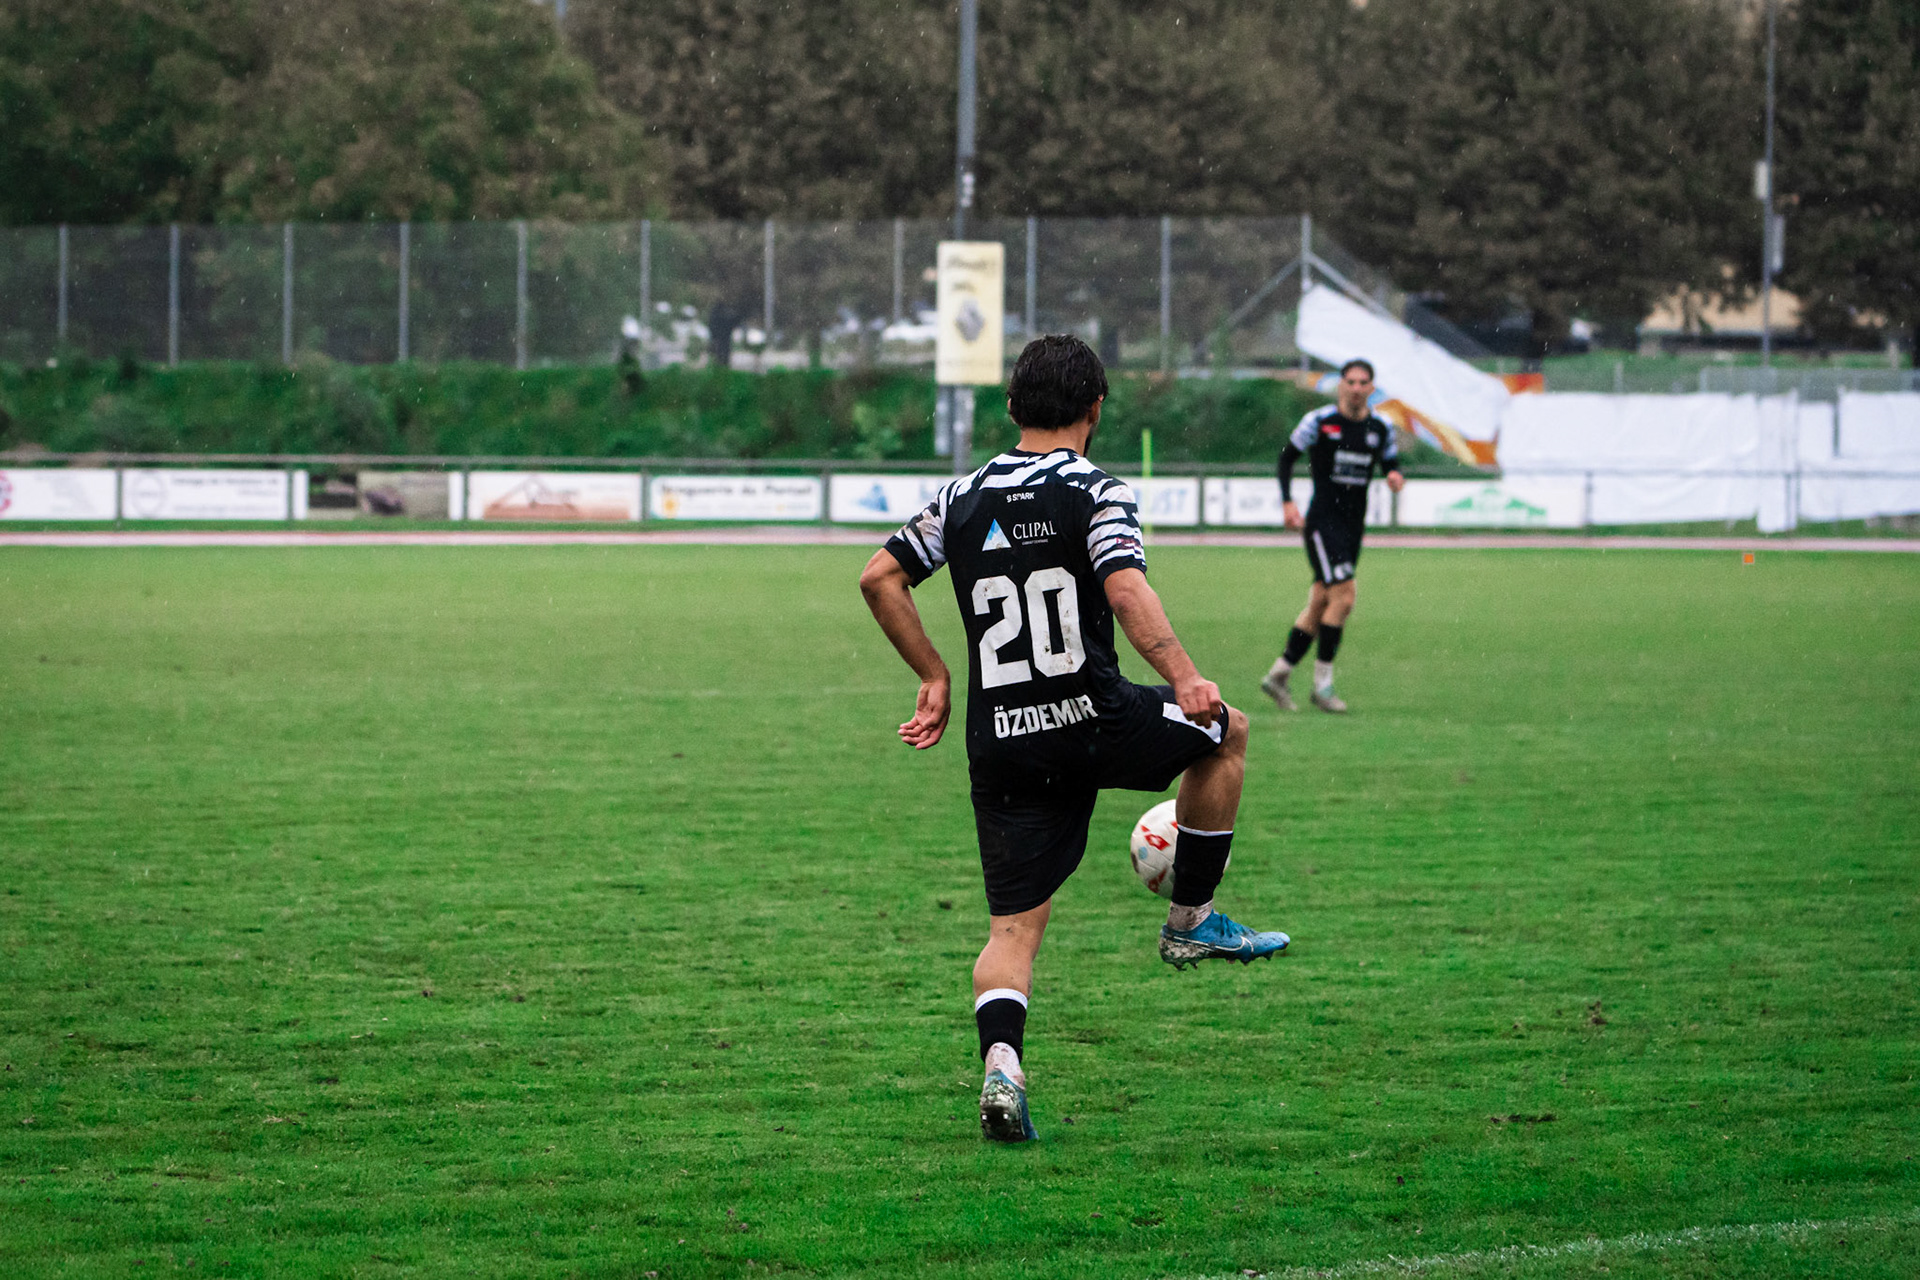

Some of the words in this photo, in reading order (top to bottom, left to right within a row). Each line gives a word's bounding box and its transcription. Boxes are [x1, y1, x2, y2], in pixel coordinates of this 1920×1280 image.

[1012, 491, 1035, 502] SPARK
[1012, 520, 1057, 540] CLIPAL
[971, 567, 1087, 690] 20
[994, 695, 1098, 739] ÖZDEMIR
